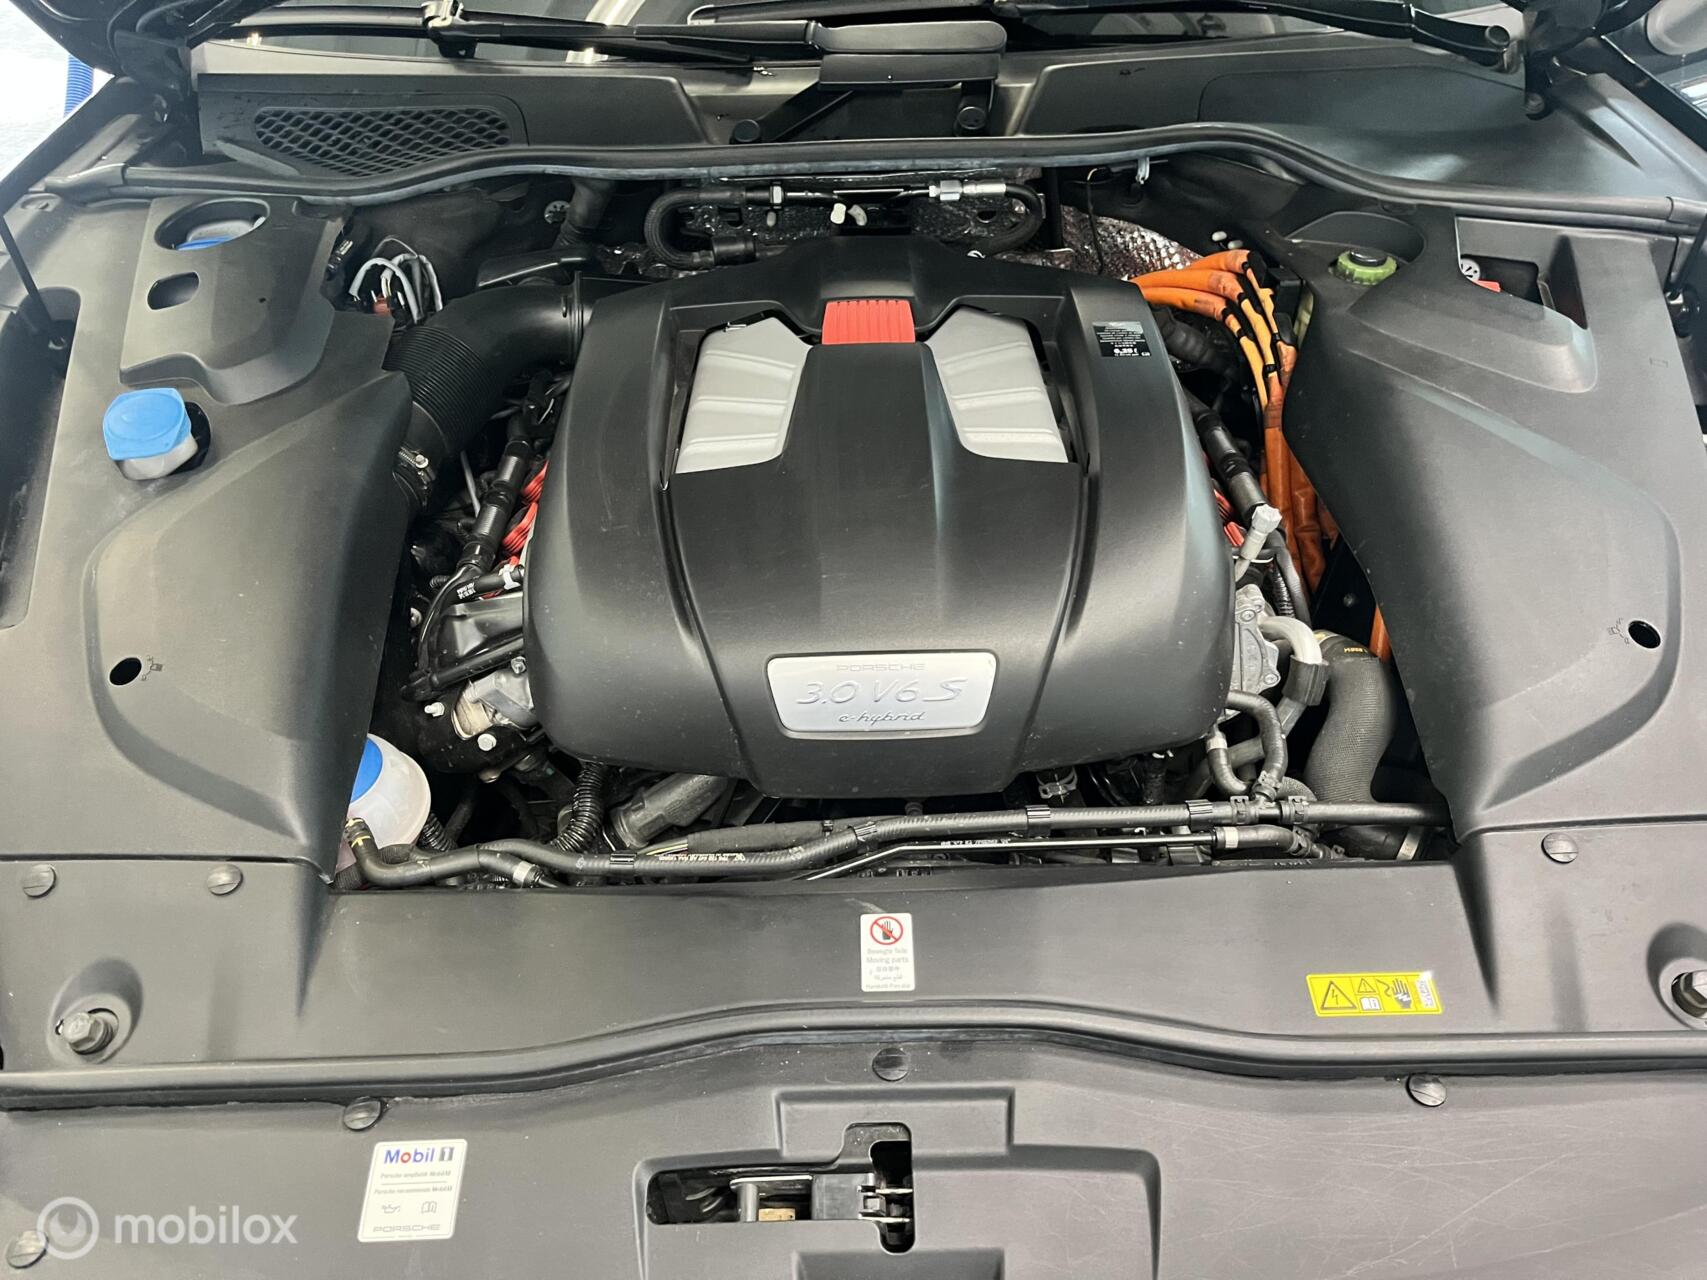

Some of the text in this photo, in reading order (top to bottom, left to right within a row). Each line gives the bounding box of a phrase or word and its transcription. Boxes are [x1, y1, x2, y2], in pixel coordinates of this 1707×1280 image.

[836, 663, 926, 672] PORSCHE
[797, 678, 969, 705] 3.0 V6 S
[838, 711, 925, 726] e-hybrid
[384, 1147, 454, 1164] Mobil 1
[373, 1224, 441, 1233] PORSCHE
